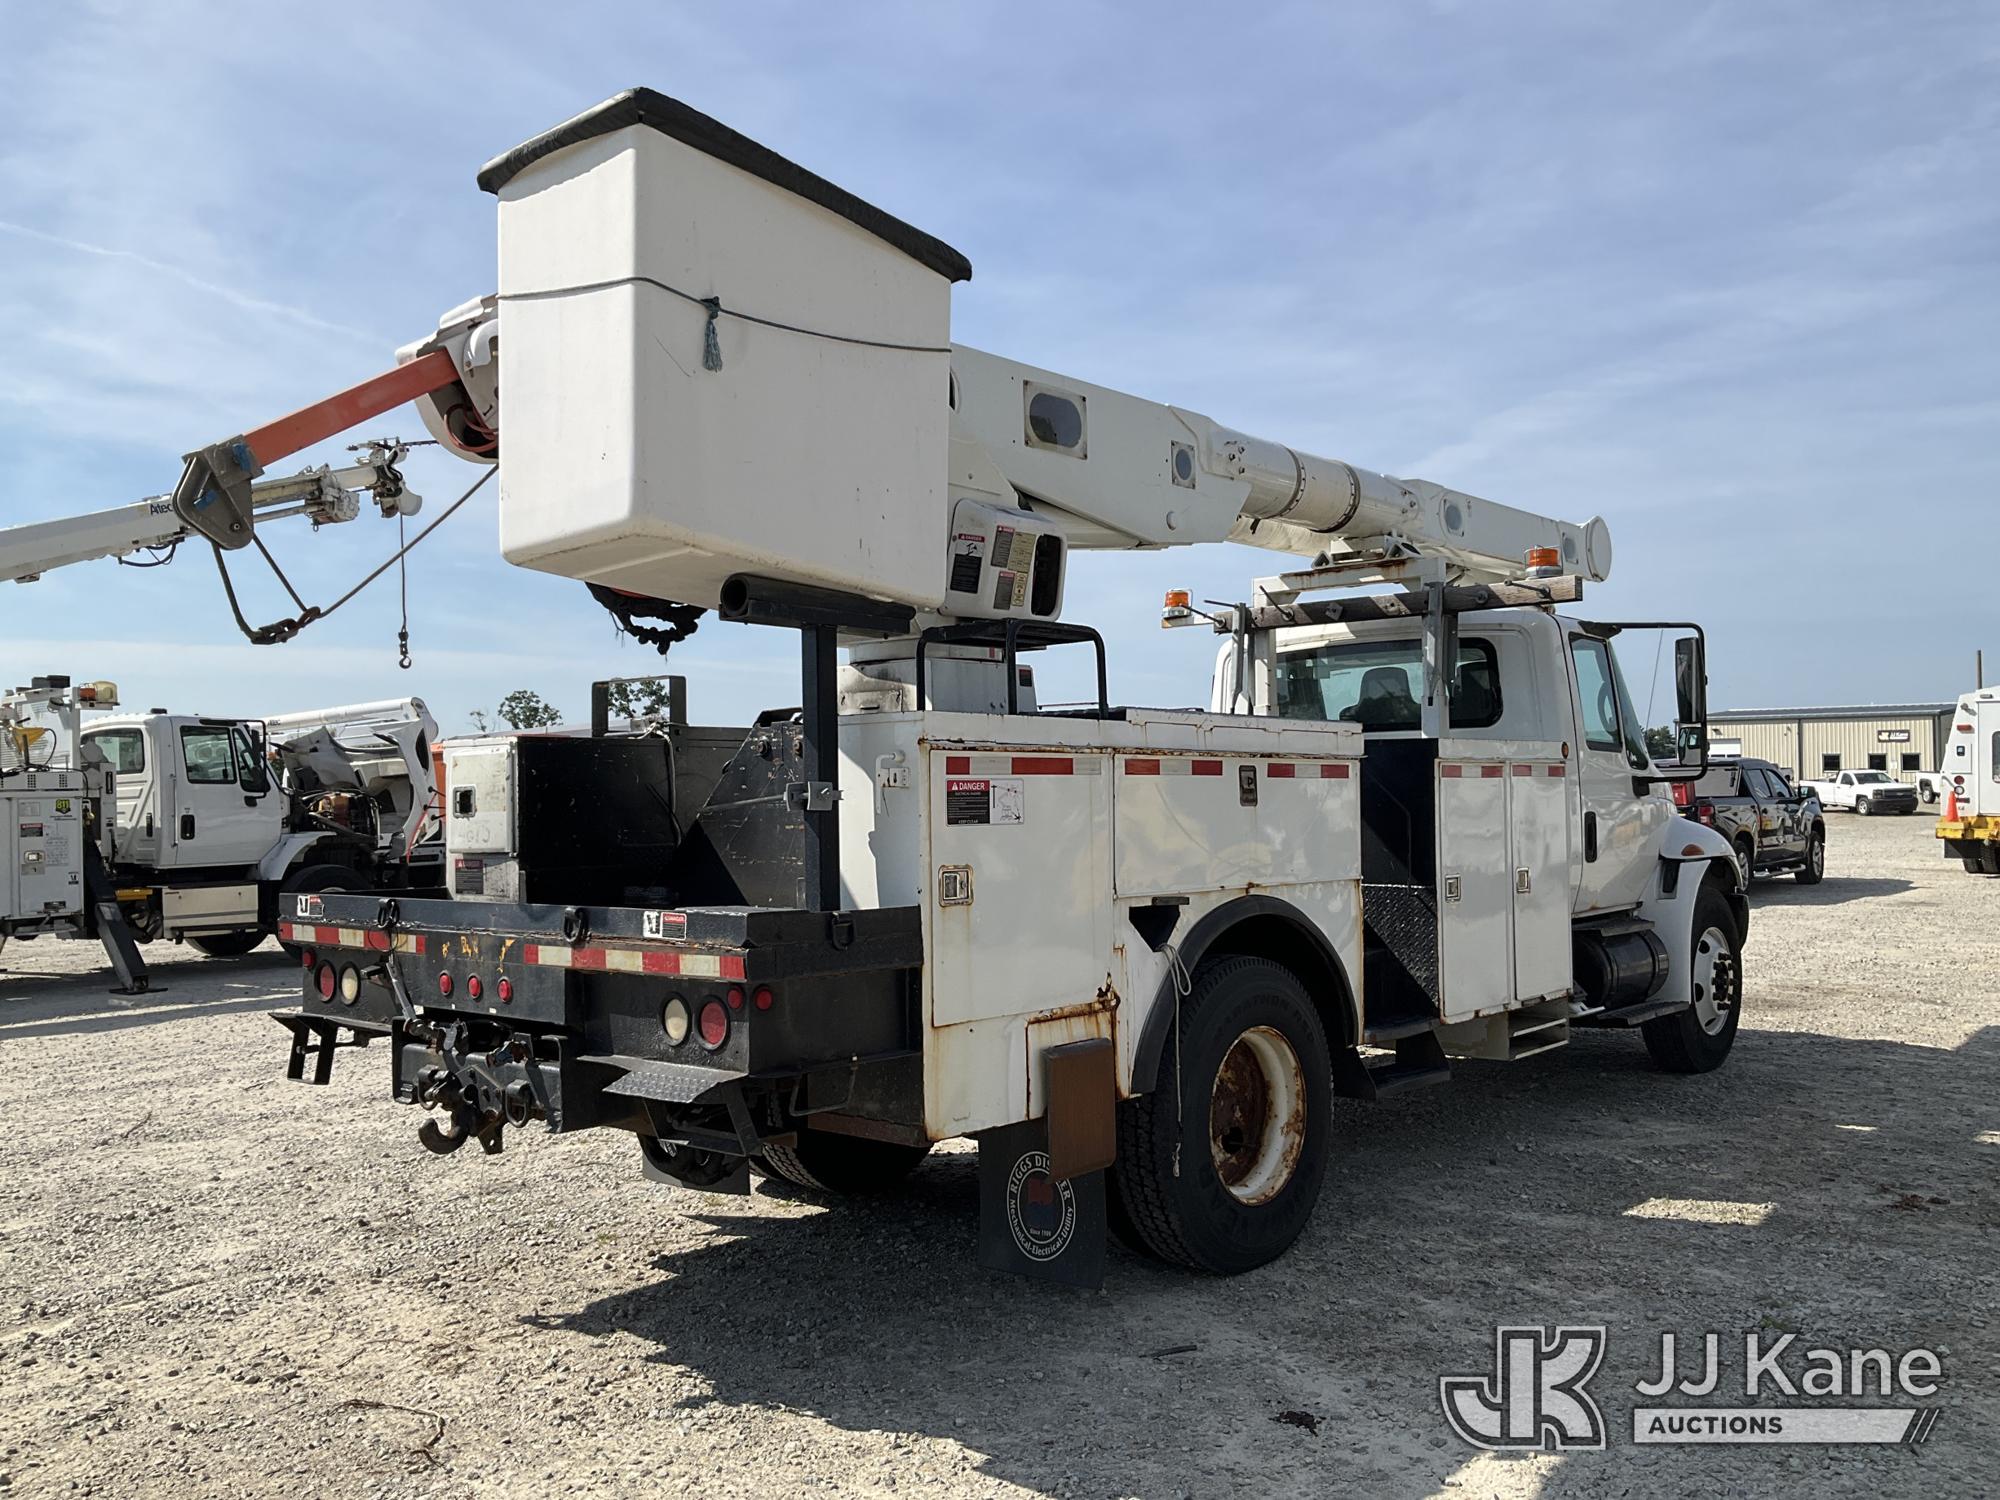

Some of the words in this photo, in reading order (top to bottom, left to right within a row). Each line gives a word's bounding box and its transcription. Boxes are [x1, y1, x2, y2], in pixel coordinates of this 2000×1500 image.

[959, 782, 985, 790] DANGER
[56, 799, 70, 809] 811
[1010, 1157, 1032, 1194] RIGGS
